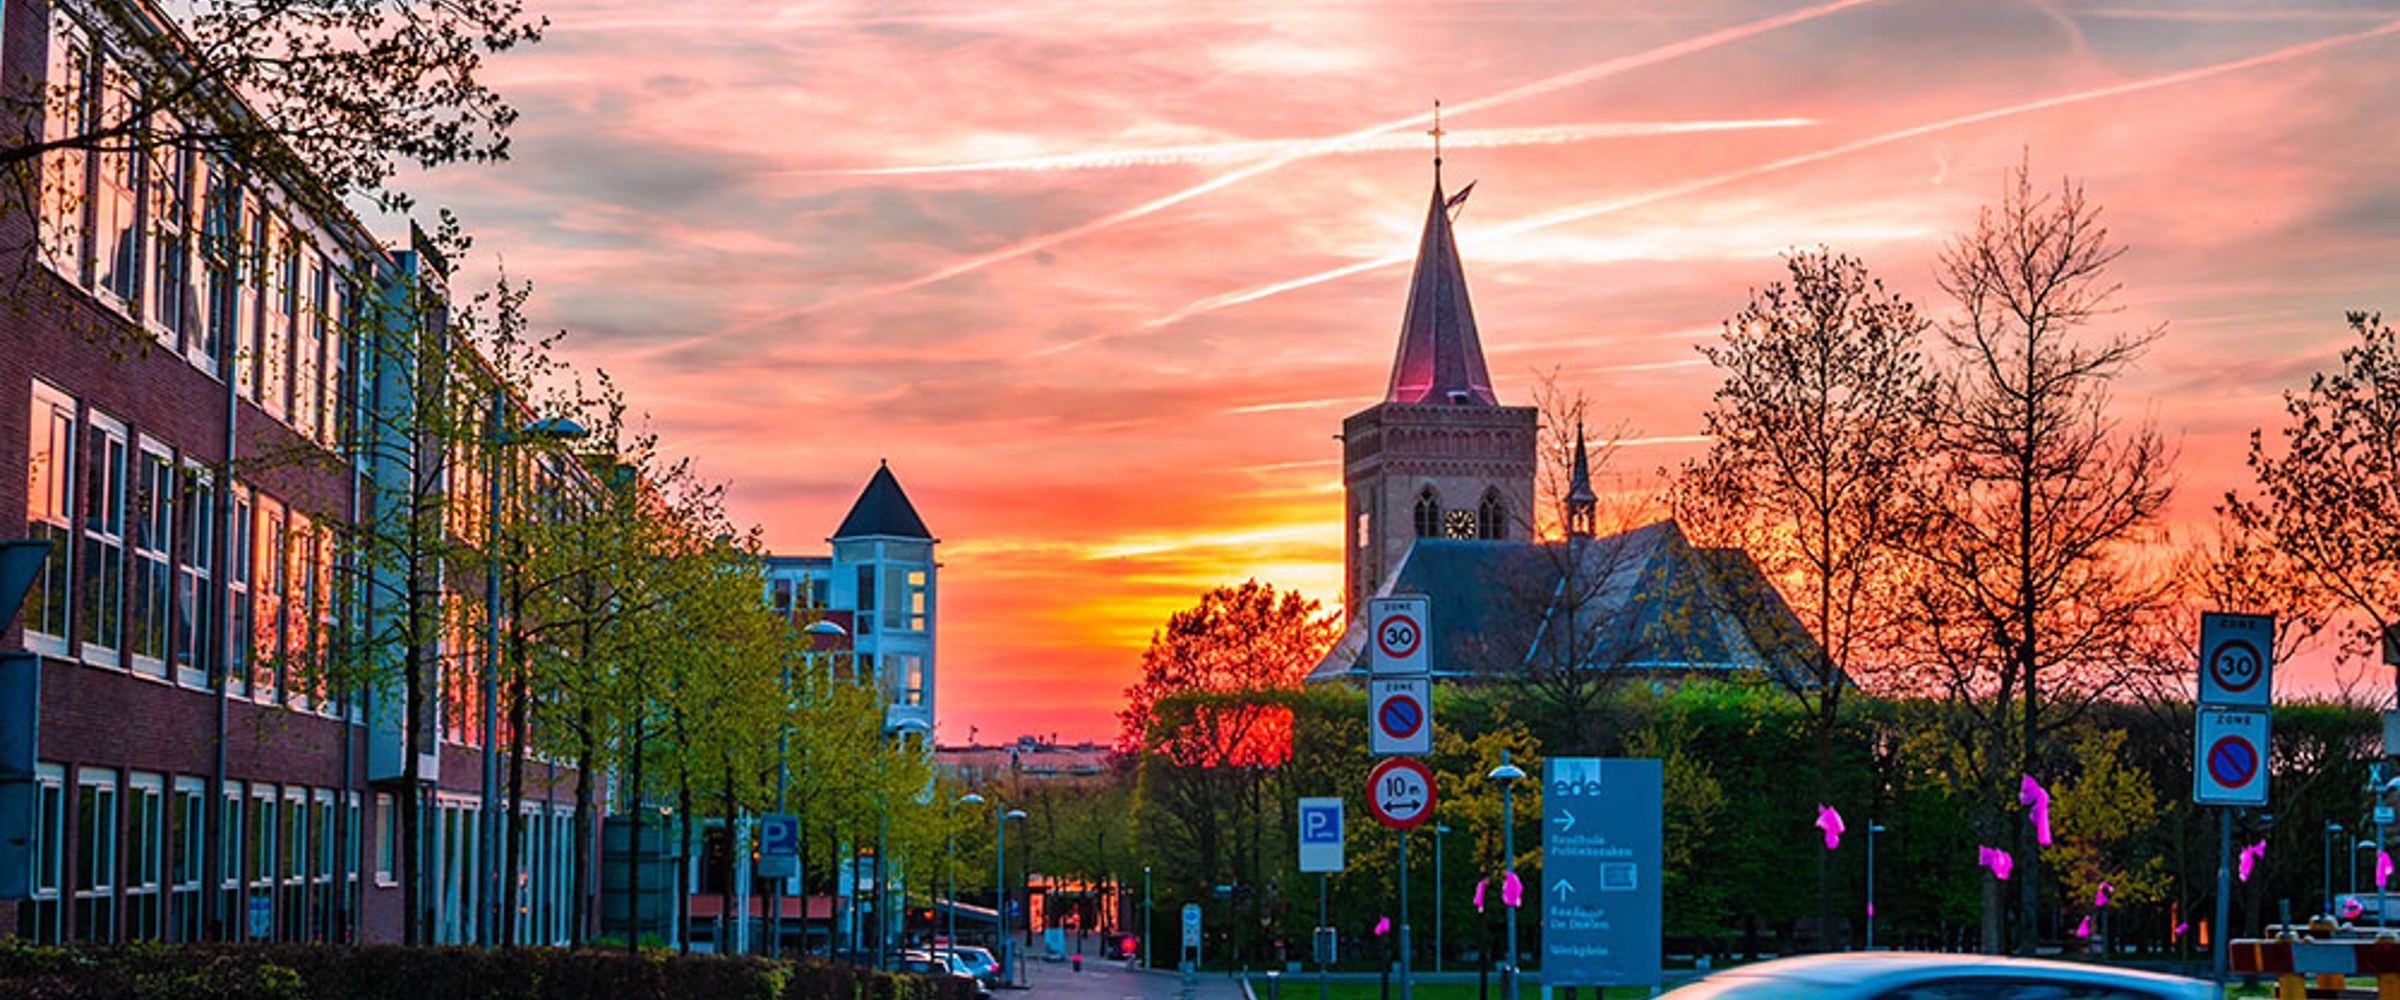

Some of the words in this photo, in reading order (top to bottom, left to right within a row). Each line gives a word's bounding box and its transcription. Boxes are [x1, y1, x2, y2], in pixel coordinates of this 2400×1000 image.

[1384, 602, 1412, 611] ZONE
[2219, 618, 2255, 629] ZONE
[1386, 627, 1412, 645] 30
[2220, 656, 2252, 676] 30
[1386, 683, 1414, 692] ZONE
[2216, 715, 2251, 726] ZONE
[1386, 777, 1406, 797] 10
[1408, 785, 1421, 795] m
[1554, 772, 1602, 797] ede
[1307, 811, 1327, 839] P
[763, 821, 788, 854] P
